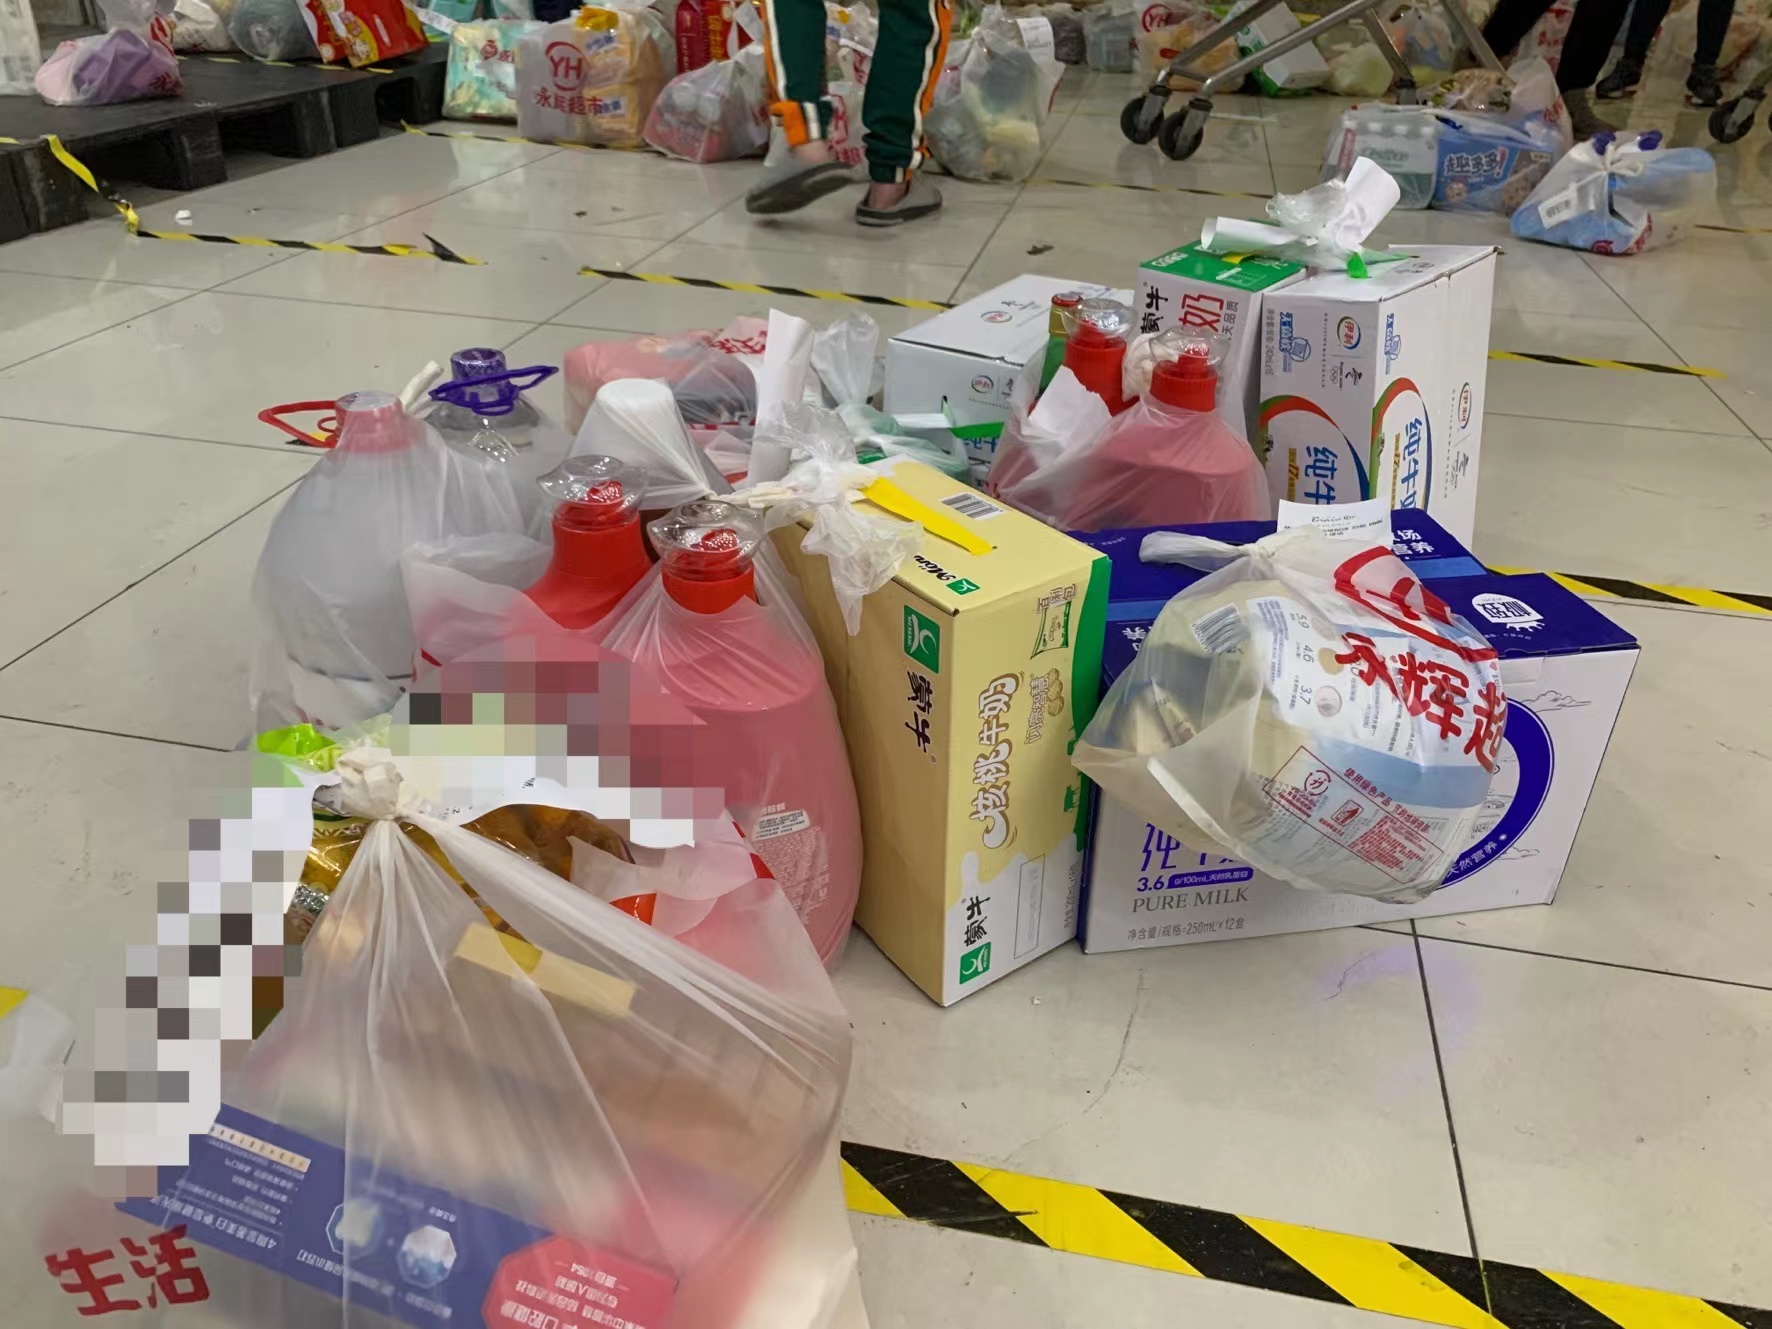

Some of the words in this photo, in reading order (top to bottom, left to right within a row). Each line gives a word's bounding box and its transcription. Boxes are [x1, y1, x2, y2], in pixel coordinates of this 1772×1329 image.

[550, 56, 583, 80] YH
[1344, 320, 1355, 345] 伊利
[1303, 644, 1315, 664] 4.6
[1300, 685, 1312, 705] 3.7
[905, 671, 933, 753] 蒙牛
[1024, 677, 1049, 745] 闪亮智慧
[969, 673, 1020, 849] 核桃牛奶
[1136, 875, 1165, 892] 3.6
[1132, 893, 1188, 913] PURE
[1193, 887, 1249, 907] MILK
[964, 896, 991, 947] 蒙牛
[45, 1224, 211, 1317] 生活
